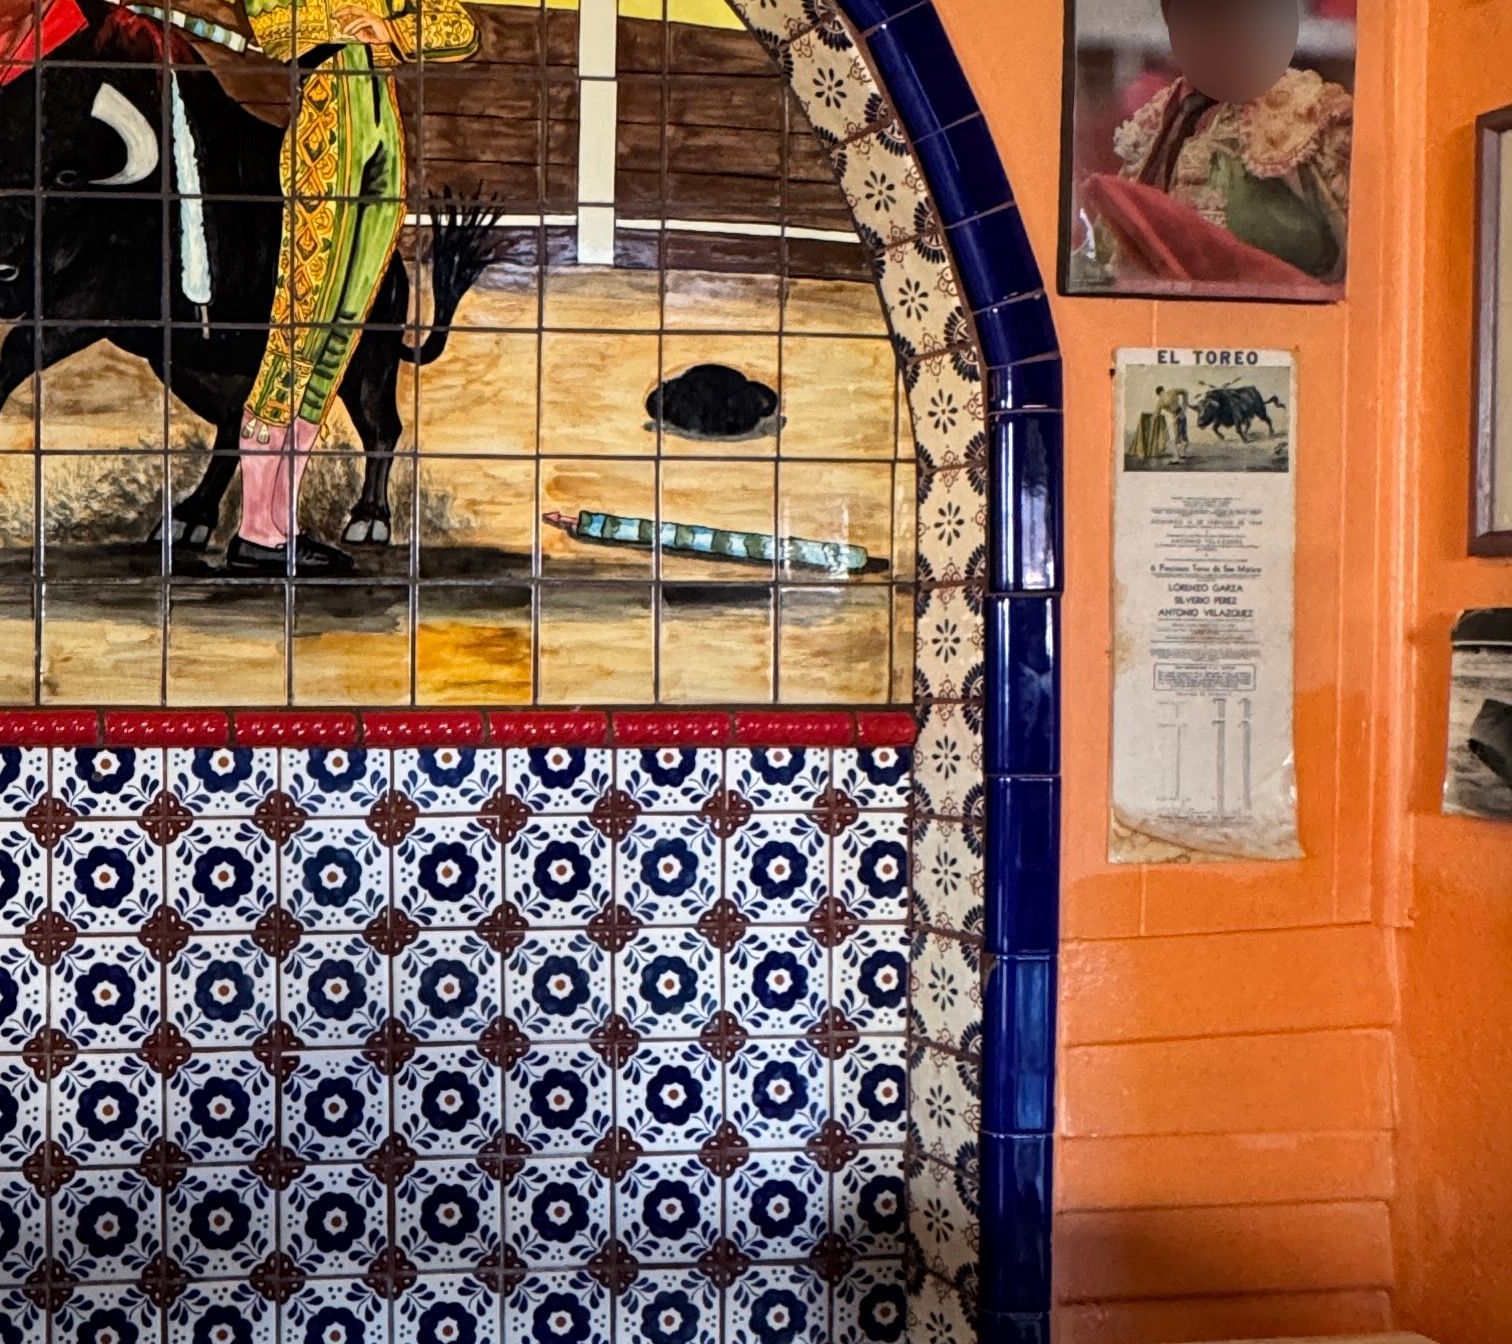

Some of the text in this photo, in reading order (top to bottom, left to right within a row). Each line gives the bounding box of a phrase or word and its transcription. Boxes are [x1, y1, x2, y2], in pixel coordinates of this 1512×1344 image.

[1157, 349, 1259, 366] EL TOREO
[1168, 583, 1244, 593] LORENZO GARZA
[1213, 596, 1238, 605] PEREZ
[1158, 608, 1199, 617] ANTONIO
